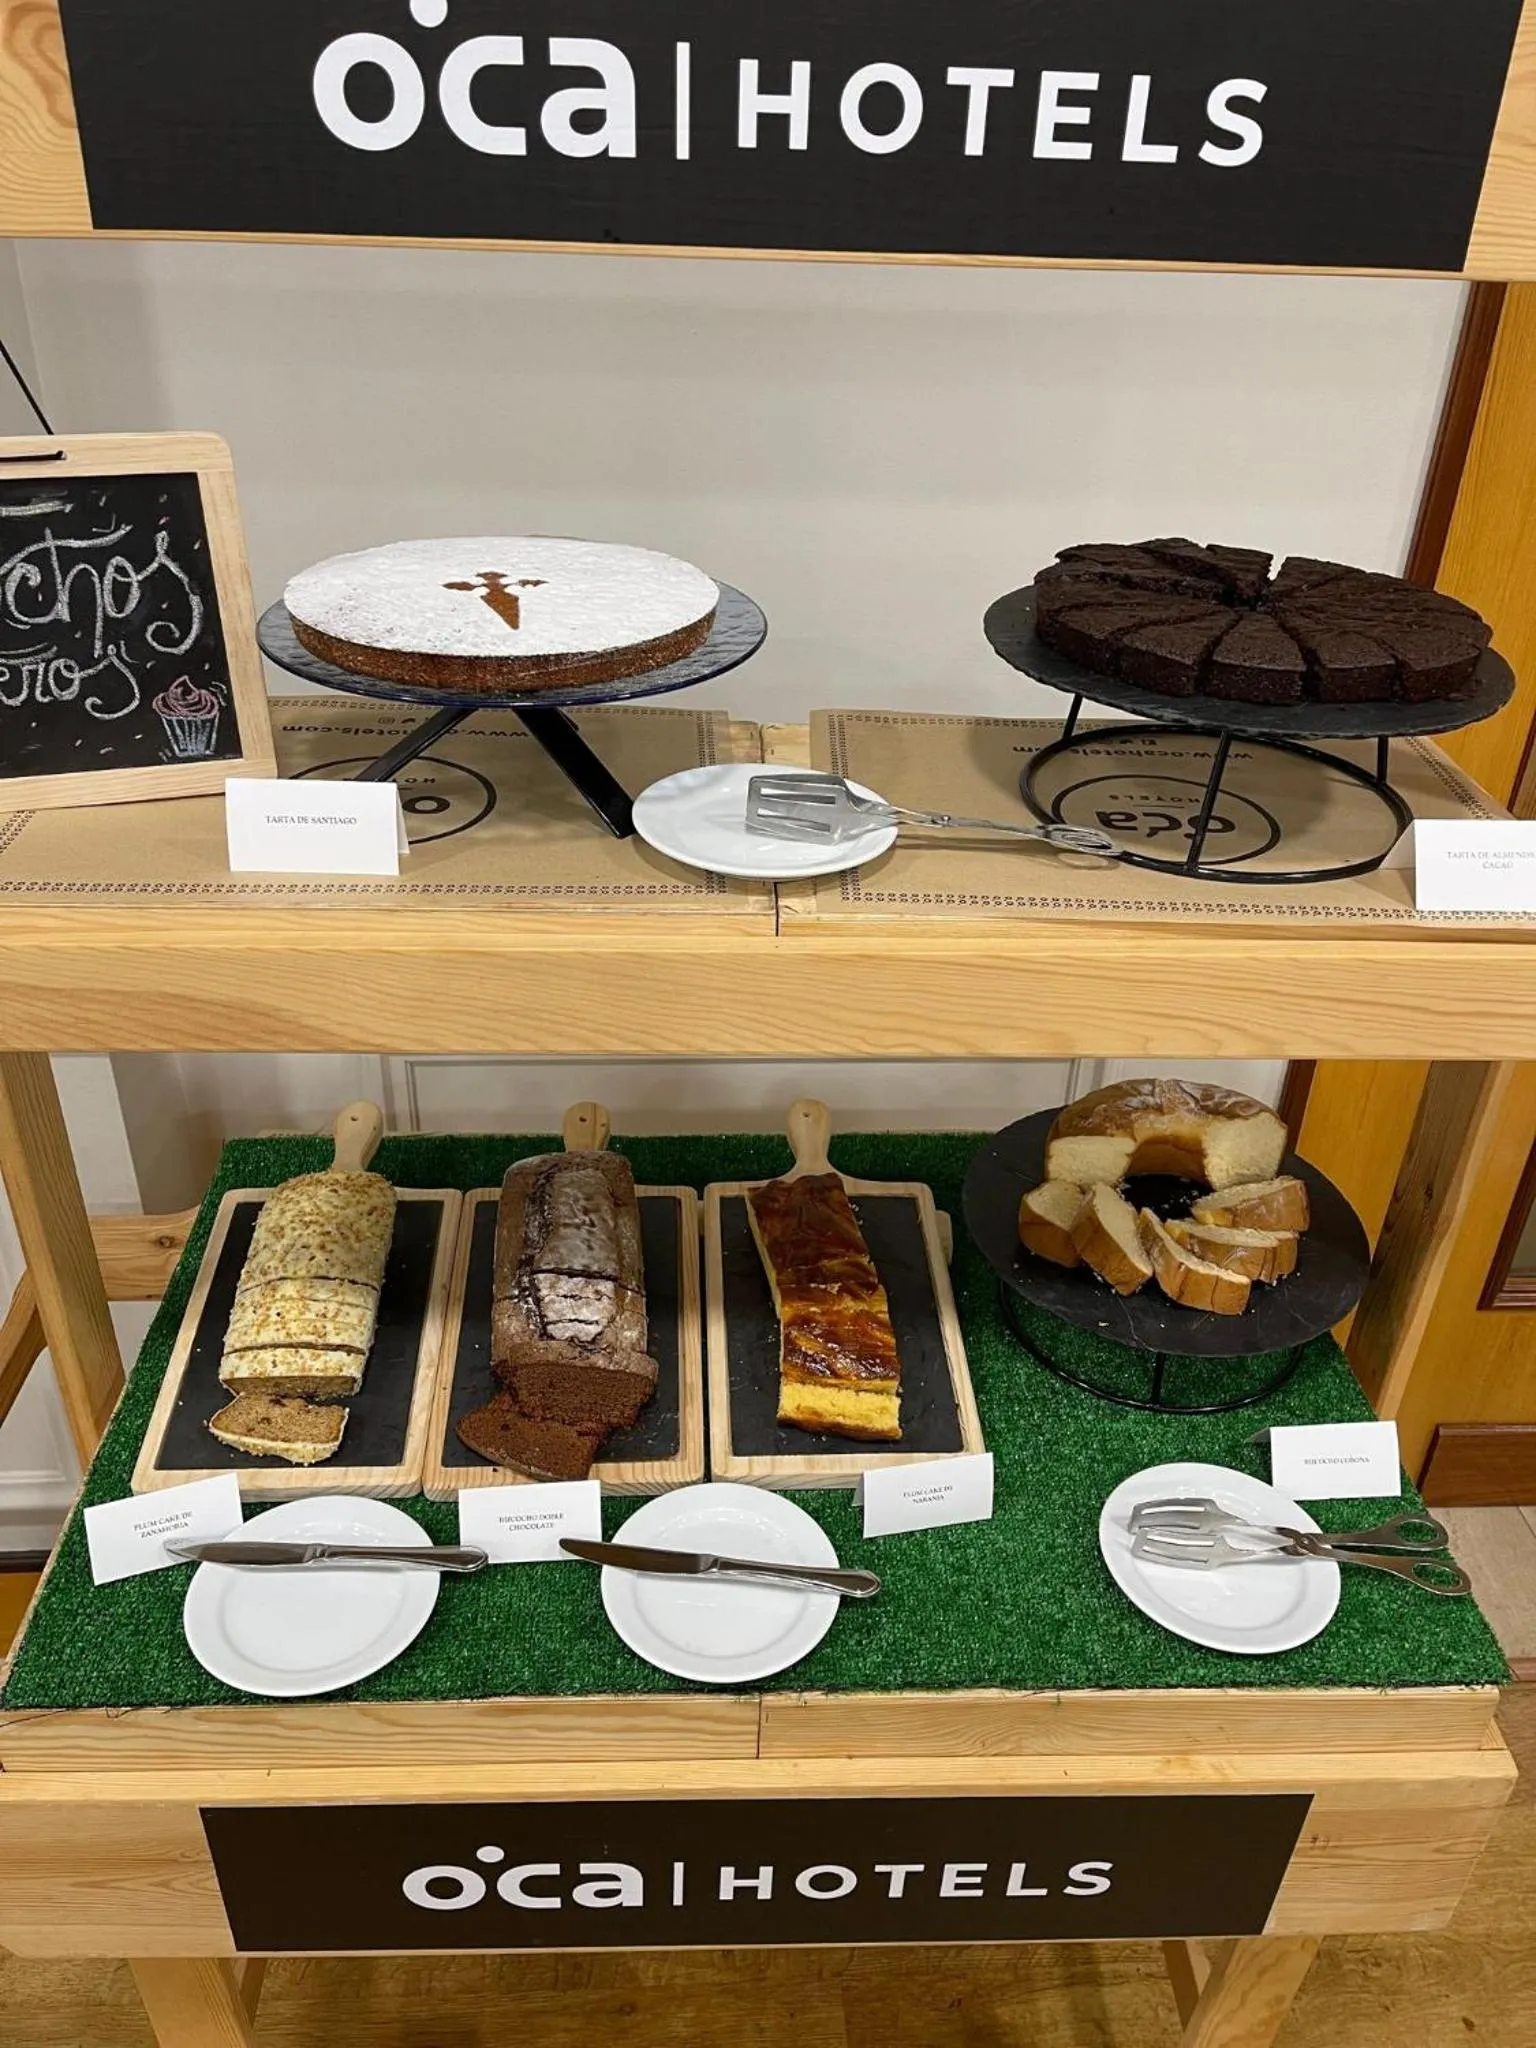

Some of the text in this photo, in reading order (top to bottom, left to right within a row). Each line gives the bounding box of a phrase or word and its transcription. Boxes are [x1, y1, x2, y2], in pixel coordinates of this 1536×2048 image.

[737, 58, 1269, 167] HOTELS
[264, 815, 358, 826] TARTA DE SANTIAGO
[1447, 850, 1477, 860] TARTA
[1482, 860, 1514, 870] CACAO
[133, 1510, 193, 1532] PLUM CAKE DE
[508, 1521, 555, 1532] CHOCOLATE
[141, 1521, 189, 1539] ZANAHORIA
[718, 1860, 1114, 1900] HOTELS
